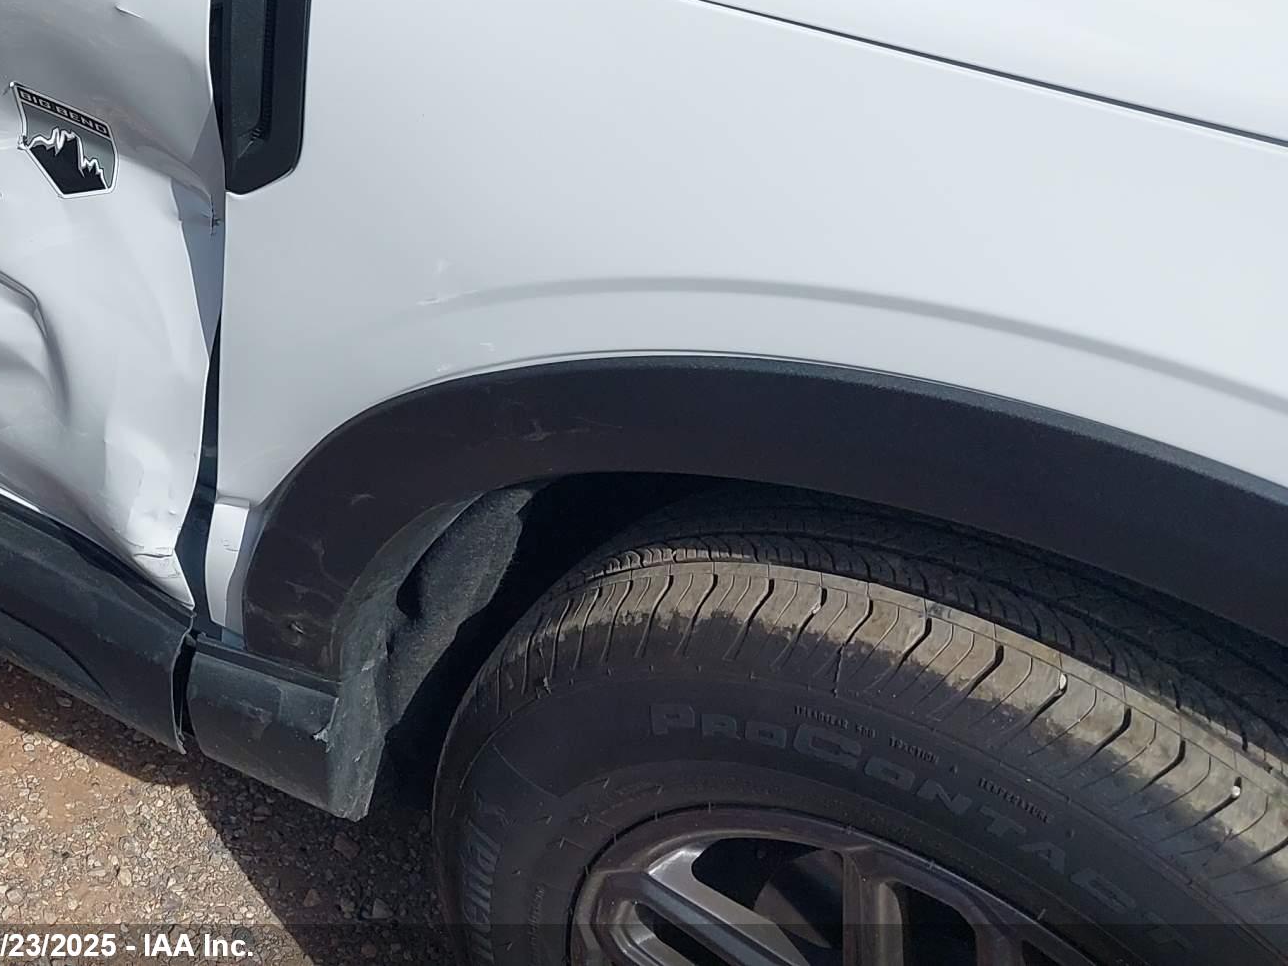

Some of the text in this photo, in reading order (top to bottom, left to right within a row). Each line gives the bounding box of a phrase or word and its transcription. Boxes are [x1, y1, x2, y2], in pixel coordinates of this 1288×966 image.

[19, 90, 108, 133] BIG BEND
[977, 777, 1051, 824] TEMPERATURE
